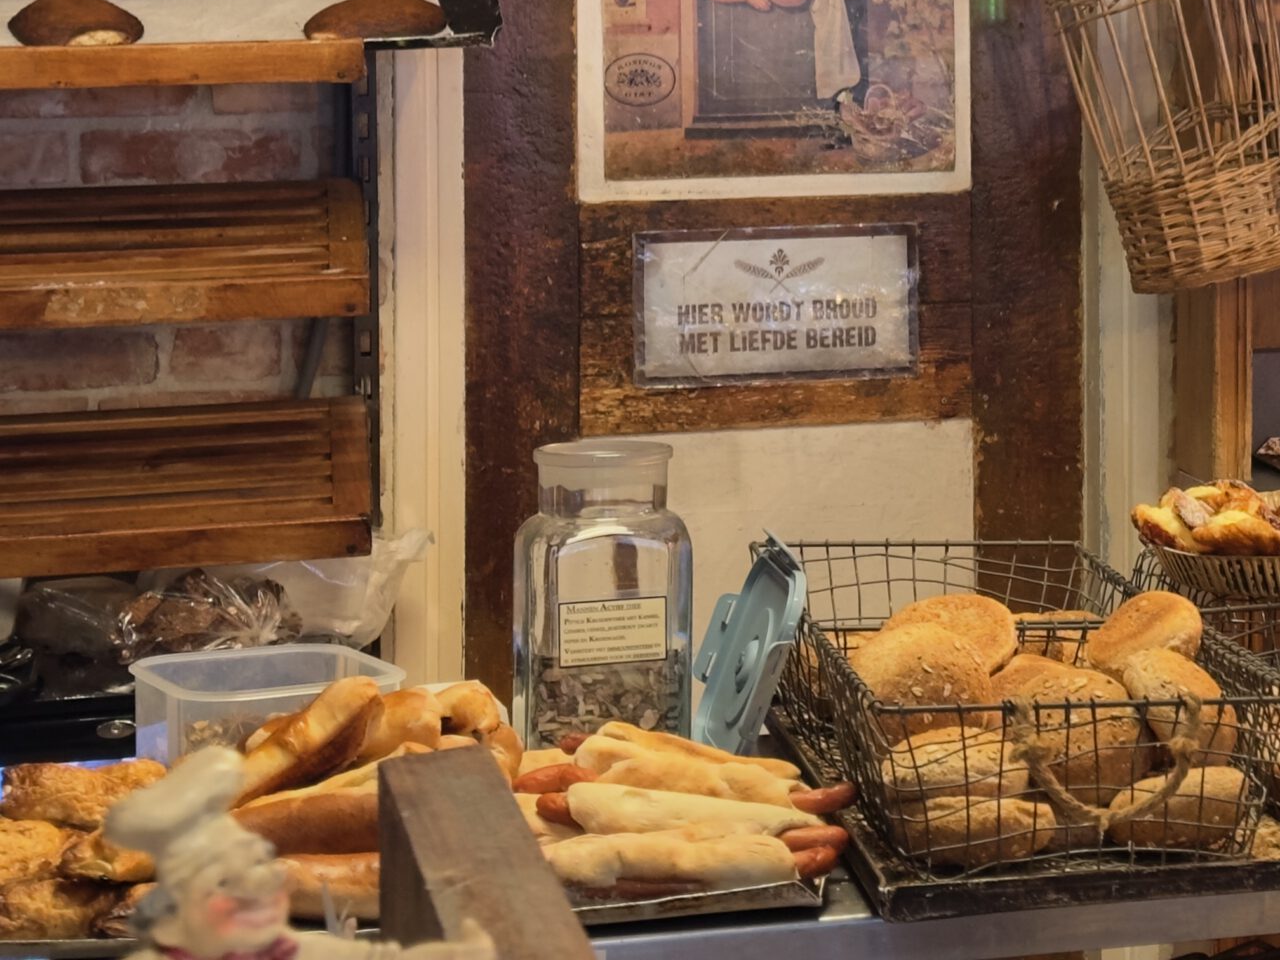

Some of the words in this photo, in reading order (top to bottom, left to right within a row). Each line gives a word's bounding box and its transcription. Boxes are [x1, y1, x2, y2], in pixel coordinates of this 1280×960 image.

[677, 303, 723, 325] HIER
[731, 300, 804, 323] WORDT
[679, 332, 721, 354] MET
[806, 325, 876, 349] BEREID
